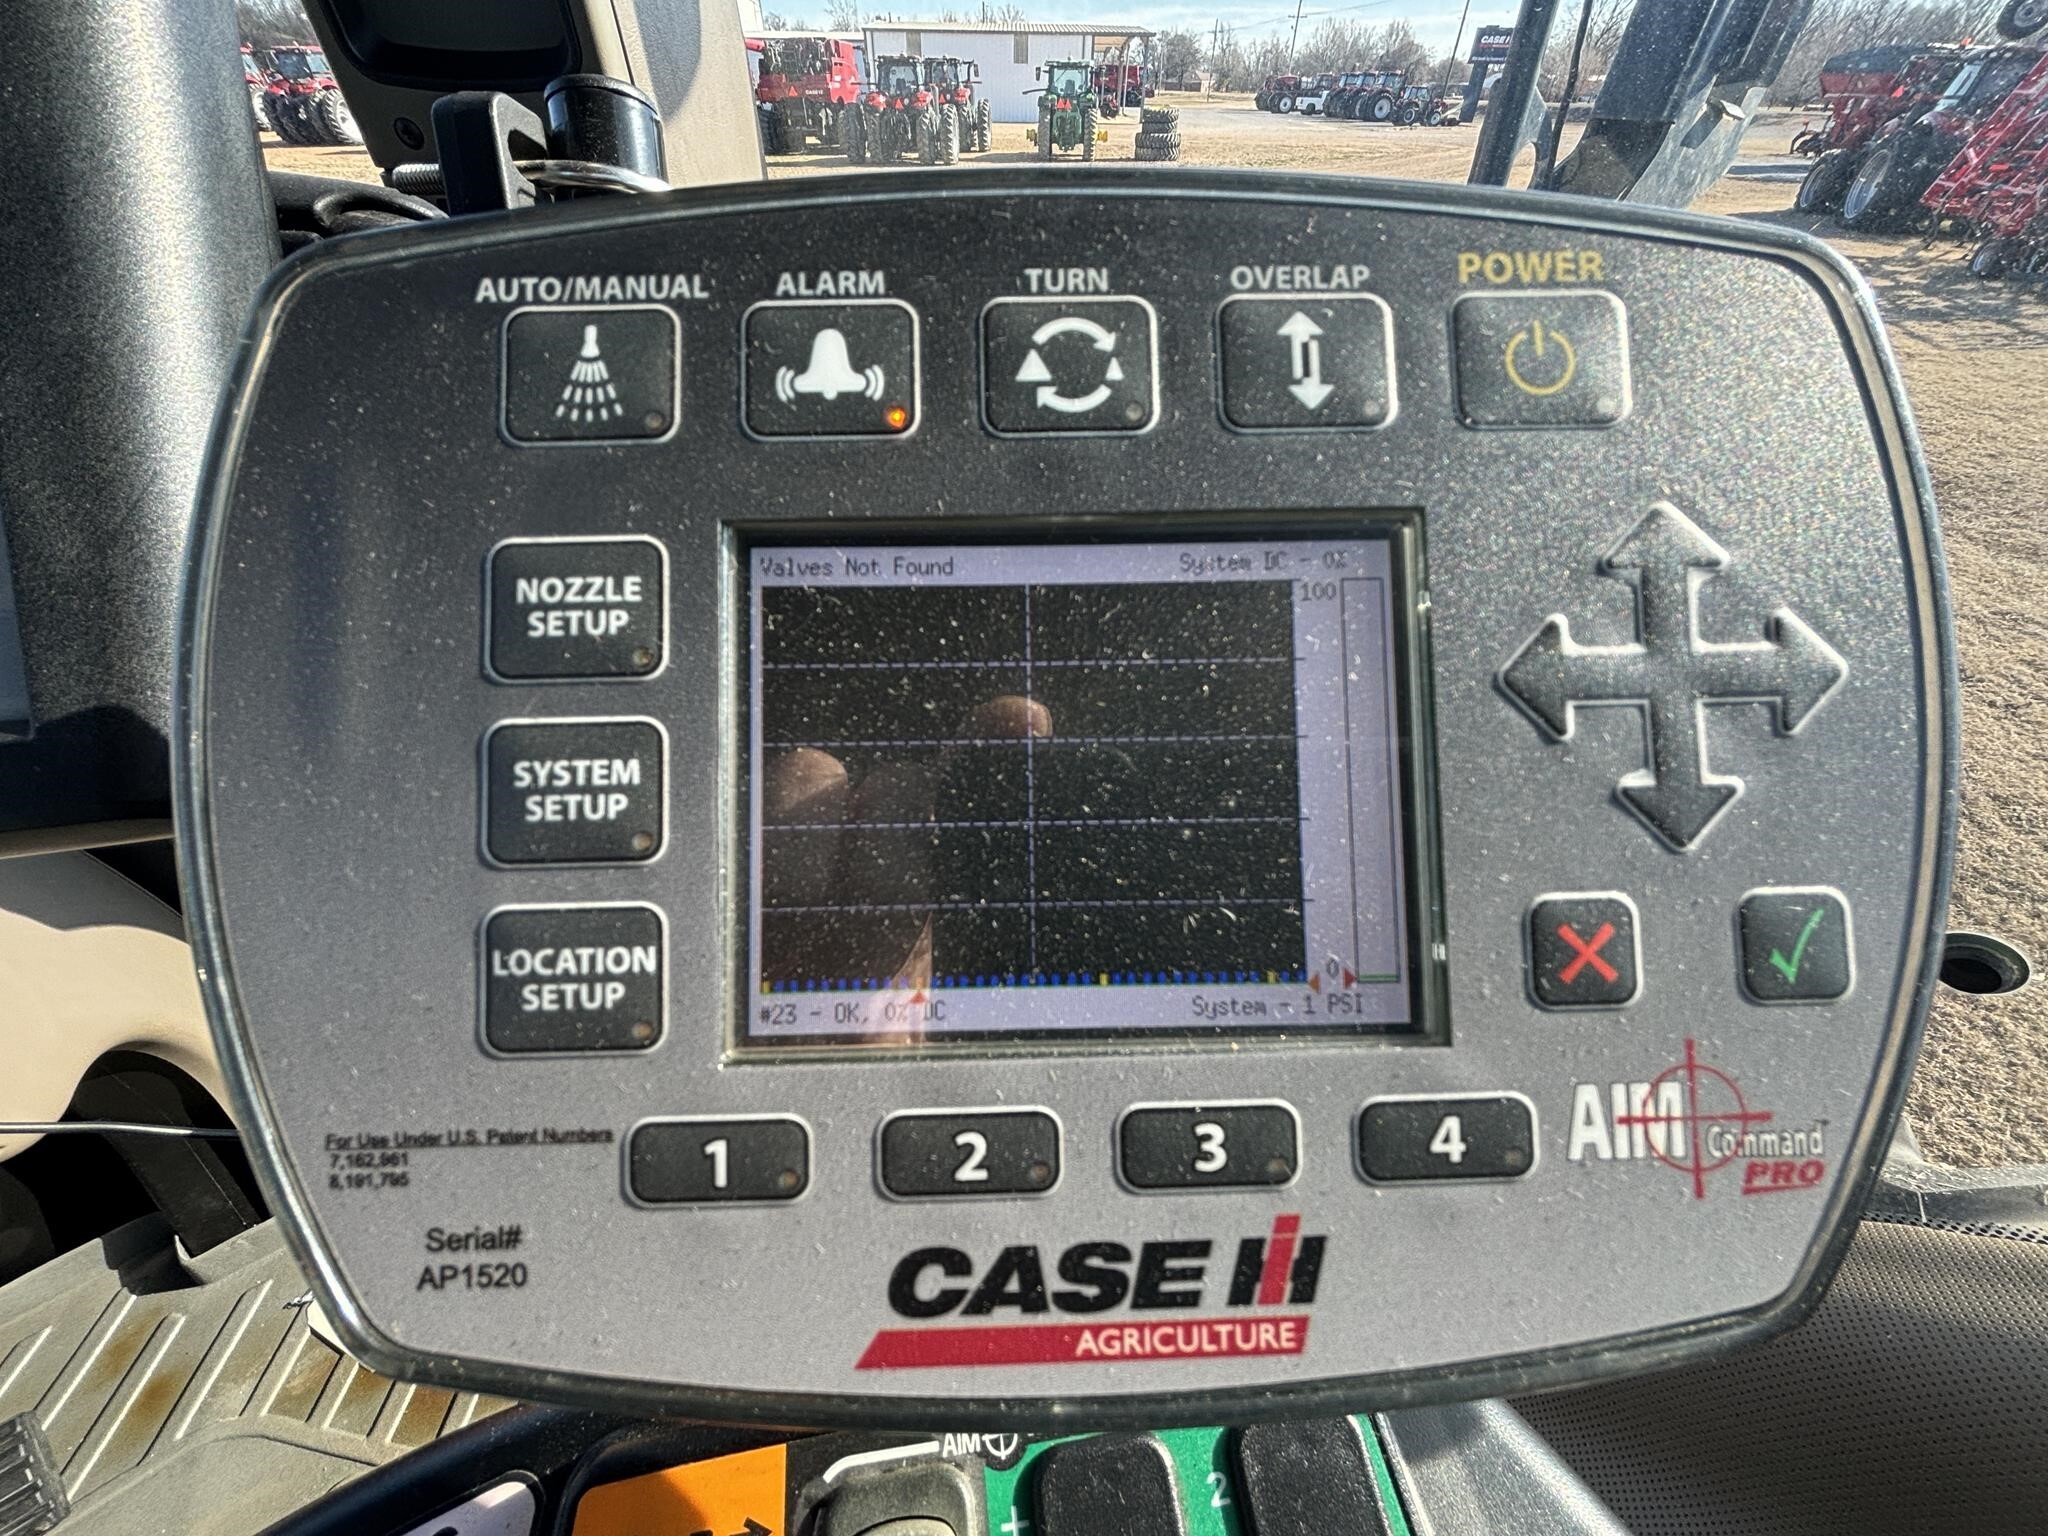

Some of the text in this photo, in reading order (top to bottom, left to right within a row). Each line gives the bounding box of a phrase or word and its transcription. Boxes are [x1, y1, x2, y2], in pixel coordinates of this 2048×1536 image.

[1480, 35, 1505, 44] CASE
[1024, 267, 1109, 292] TURN
[1230, 264, 1369, 290] OVERLAP
[1458, 251, 1603, 284] POWER
[476, 274, 709, 302] AUTO/MANUAL
[776, 271, 886, 296] ALARM
[760, 556, 954, 577] Valves Not Found
[1179, 551, 1252, 576] System
[1263, 550, 1288, 570] DC
[516, 576, 642, 603] NOZZLE
[1301, 581, 1337, 601] 100
[527, 609, 629, 638] SETUP
[513, 759, 640, 788] SYSTEM
[525, 794, 628, 822] SETUP
[493, 946, 656, 977] LOCATION
[521, 982, 625, 1011] SETUP
[1192, 995, 1267, 1019] System
[1303, 996, 1316, 1015] 1
[1327, 993, 1364, 1015] PSI
[760, 1004, 797, 1025] #23
[924, 1000, 947, 1021] DC
[1567, 1081, 1686, 1161] AIM
[325, 1132, 353, 1151] For
[357, 1131, 390, 1150] Use
[393, 1129, 442, 1148] Under
[486, 1128, 537, 1145] Patent
[542, 1126, 614, 1144] Numbers
[1193, 1122, 1227, 1173] 3
[1430, 1114, 1468, 1164] 4
[703, 1139, 730, 1188] 1
[954, 1131, 990, 1182] 2
[1744, 1160, 1825, 1188] PRO
[426, 1225, 522, 1252] Serial#
[417, 1262, 528, 1291] AP1520
[888, 1214, 1328, 1319] CASE IH
[1075, 1321, 1296, 1357] AGRICULTURE
[942, 1432, 982, 1458] AIM
[1206, 1471, 1231, 1508] 2
